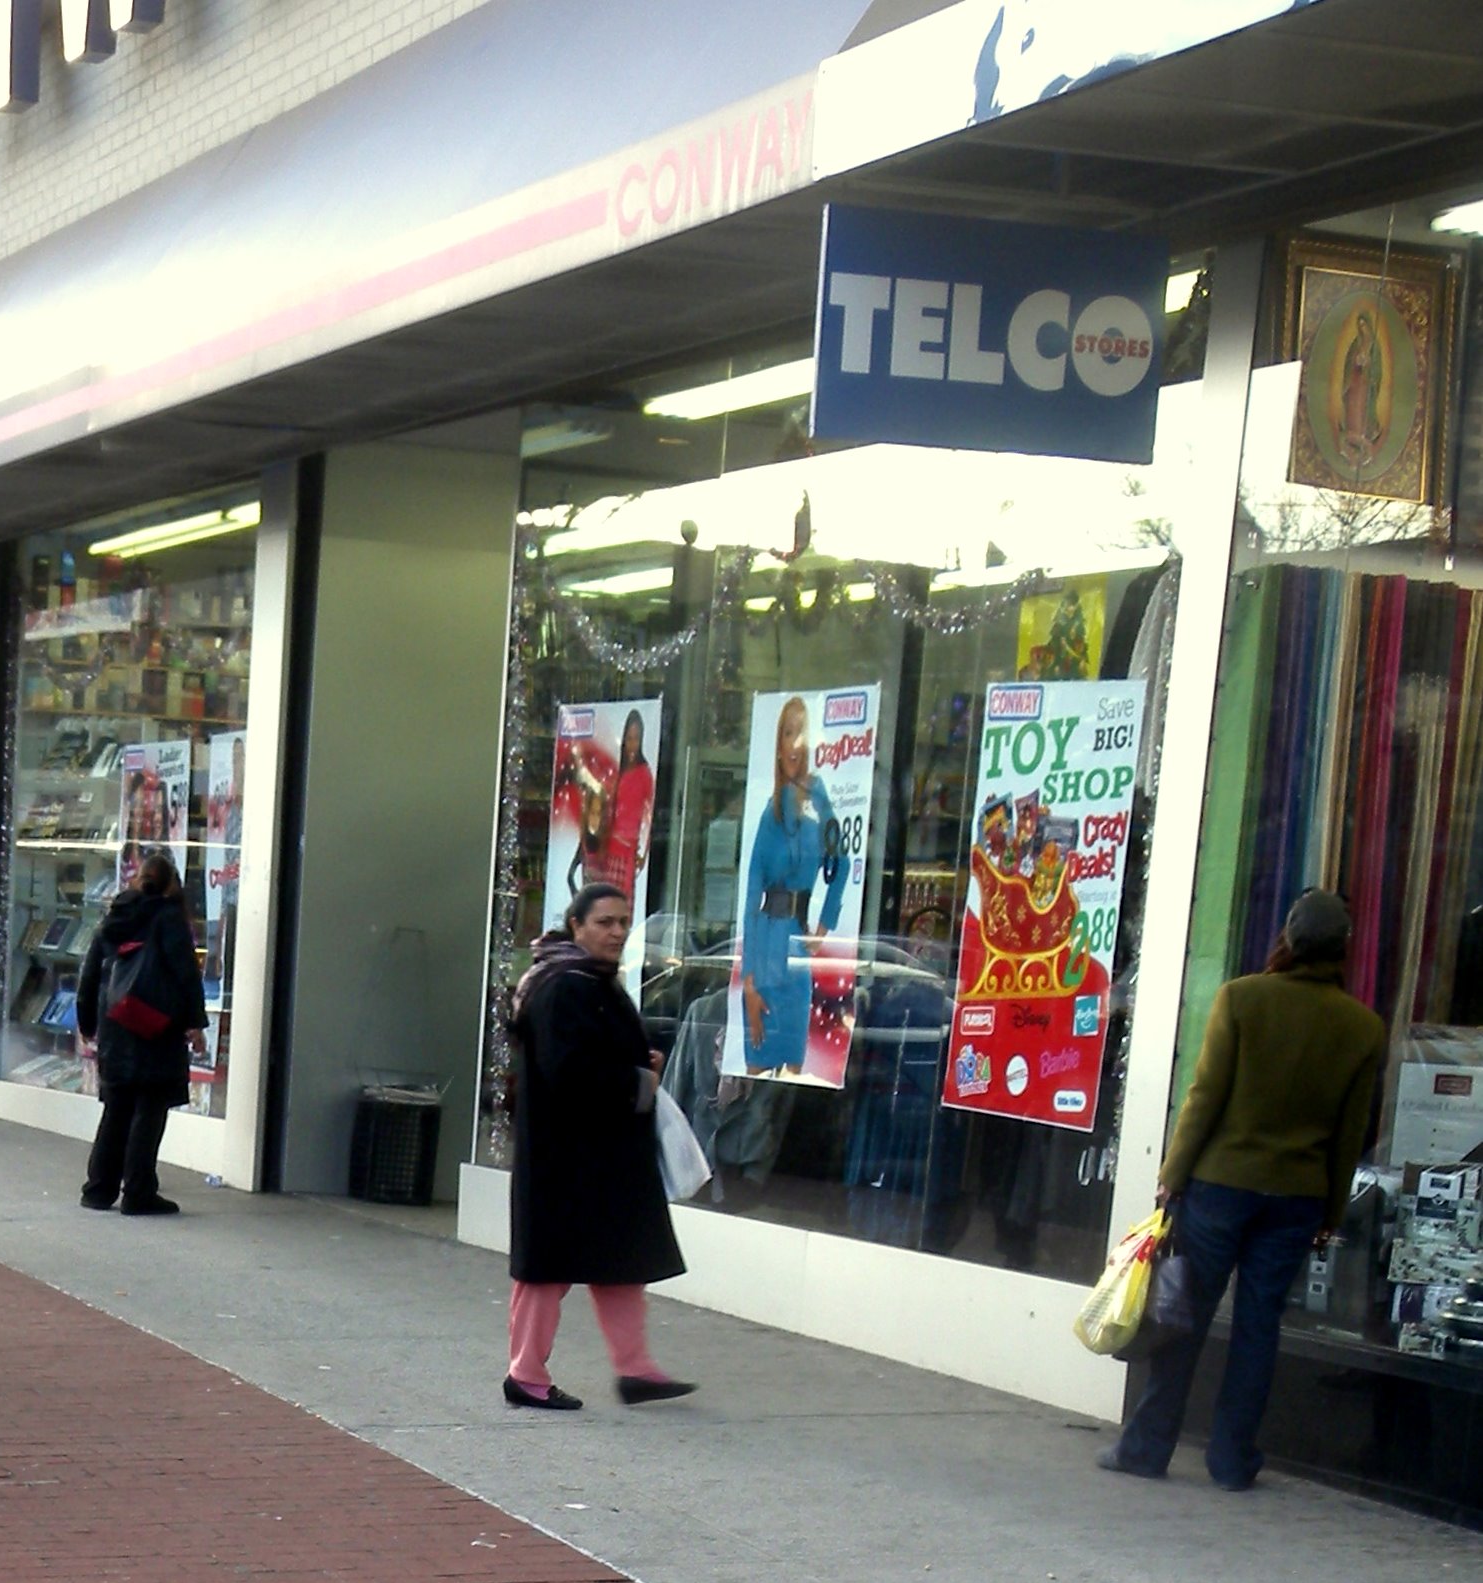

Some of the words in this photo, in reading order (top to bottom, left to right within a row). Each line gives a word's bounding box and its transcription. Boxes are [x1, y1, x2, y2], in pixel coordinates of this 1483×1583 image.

[616, 88, 814, 238] CONWAY
[829, 272, 1153, 397] TELCO
[1074, 333, 1150, 359] STORES
[991, 690, 1039, 714] CONWAY
[1098, 697, 1134, 720] Save
[984, 716, 1080, 779] TOY
[1093, 724, 1134, 751] BIG!
[1042, 765, 1134, 805] SHOP
[1083, 810, 1129, 847] Crazy
[1068, 845, 1116, 883] Deals!
[1040, 1050, 1080, 1079] Barbie
